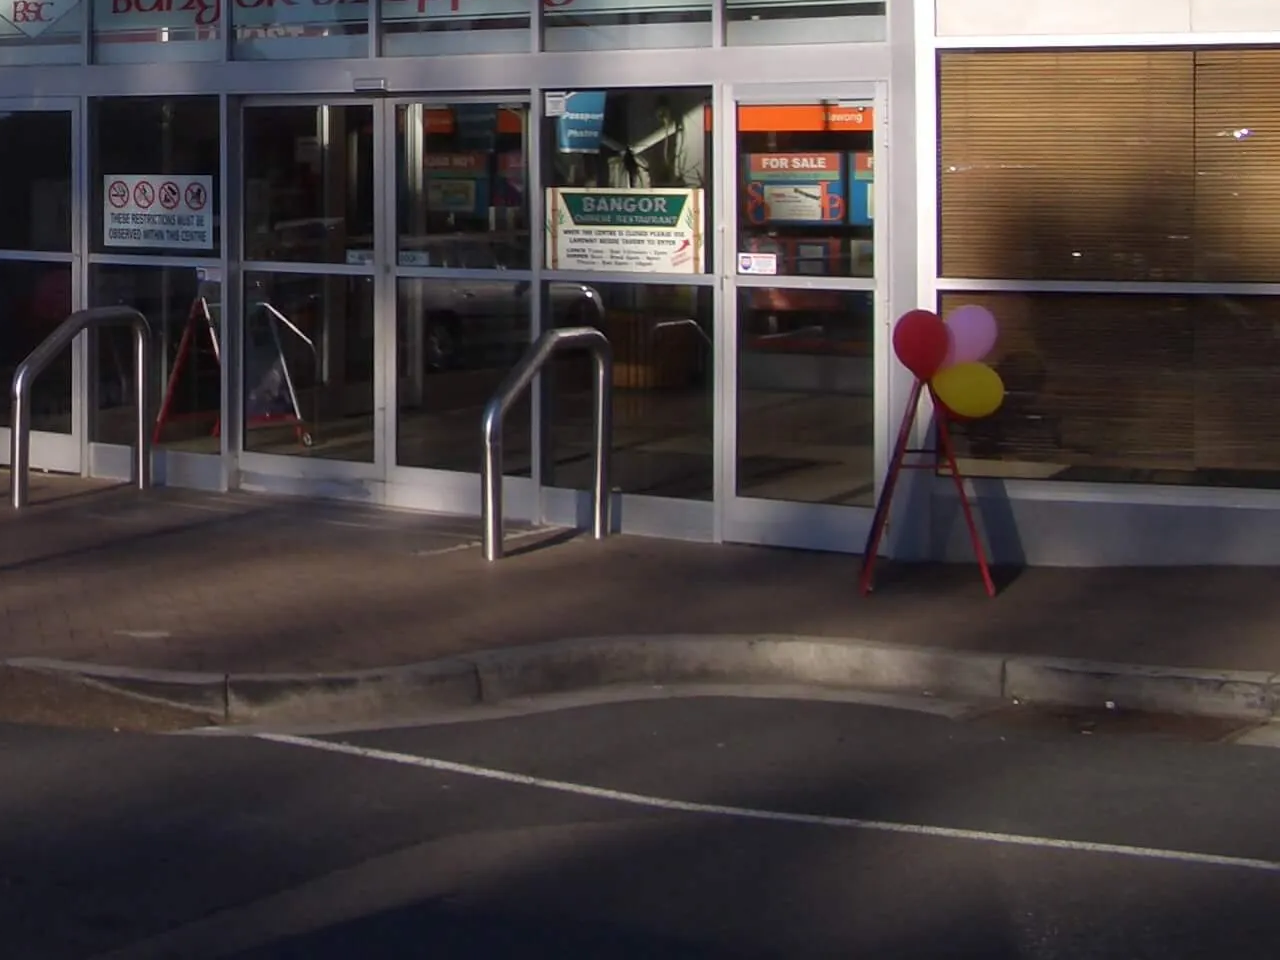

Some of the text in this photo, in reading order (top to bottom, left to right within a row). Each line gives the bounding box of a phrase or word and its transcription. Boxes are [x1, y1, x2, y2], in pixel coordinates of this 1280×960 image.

[761, 157, 827, 169] FOR SALE
[582, 196, 668, 213] BANGOR
